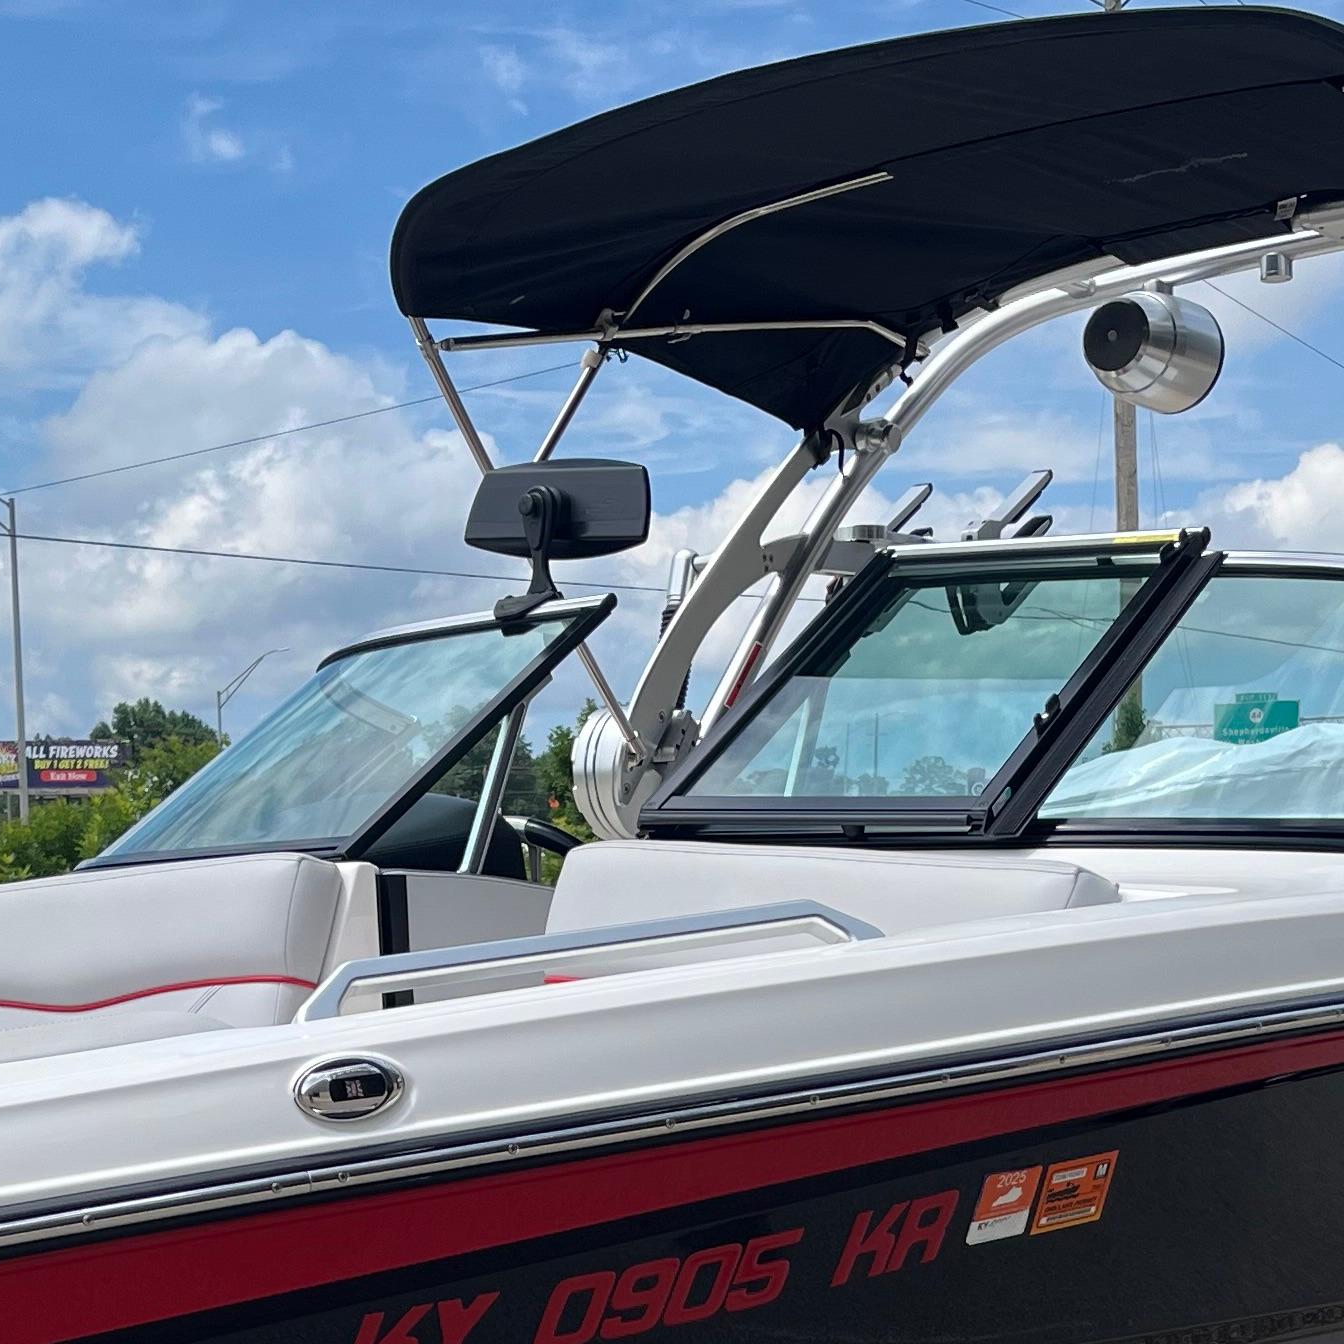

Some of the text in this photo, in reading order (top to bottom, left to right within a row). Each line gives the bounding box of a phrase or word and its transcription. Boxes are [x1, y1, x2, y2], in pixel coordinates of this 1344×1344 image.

[49, 744, 118, 759] FIREWORKS
[34, 760, 52, 770] BUY
[996, 1170, 1026, 1188] 2025
